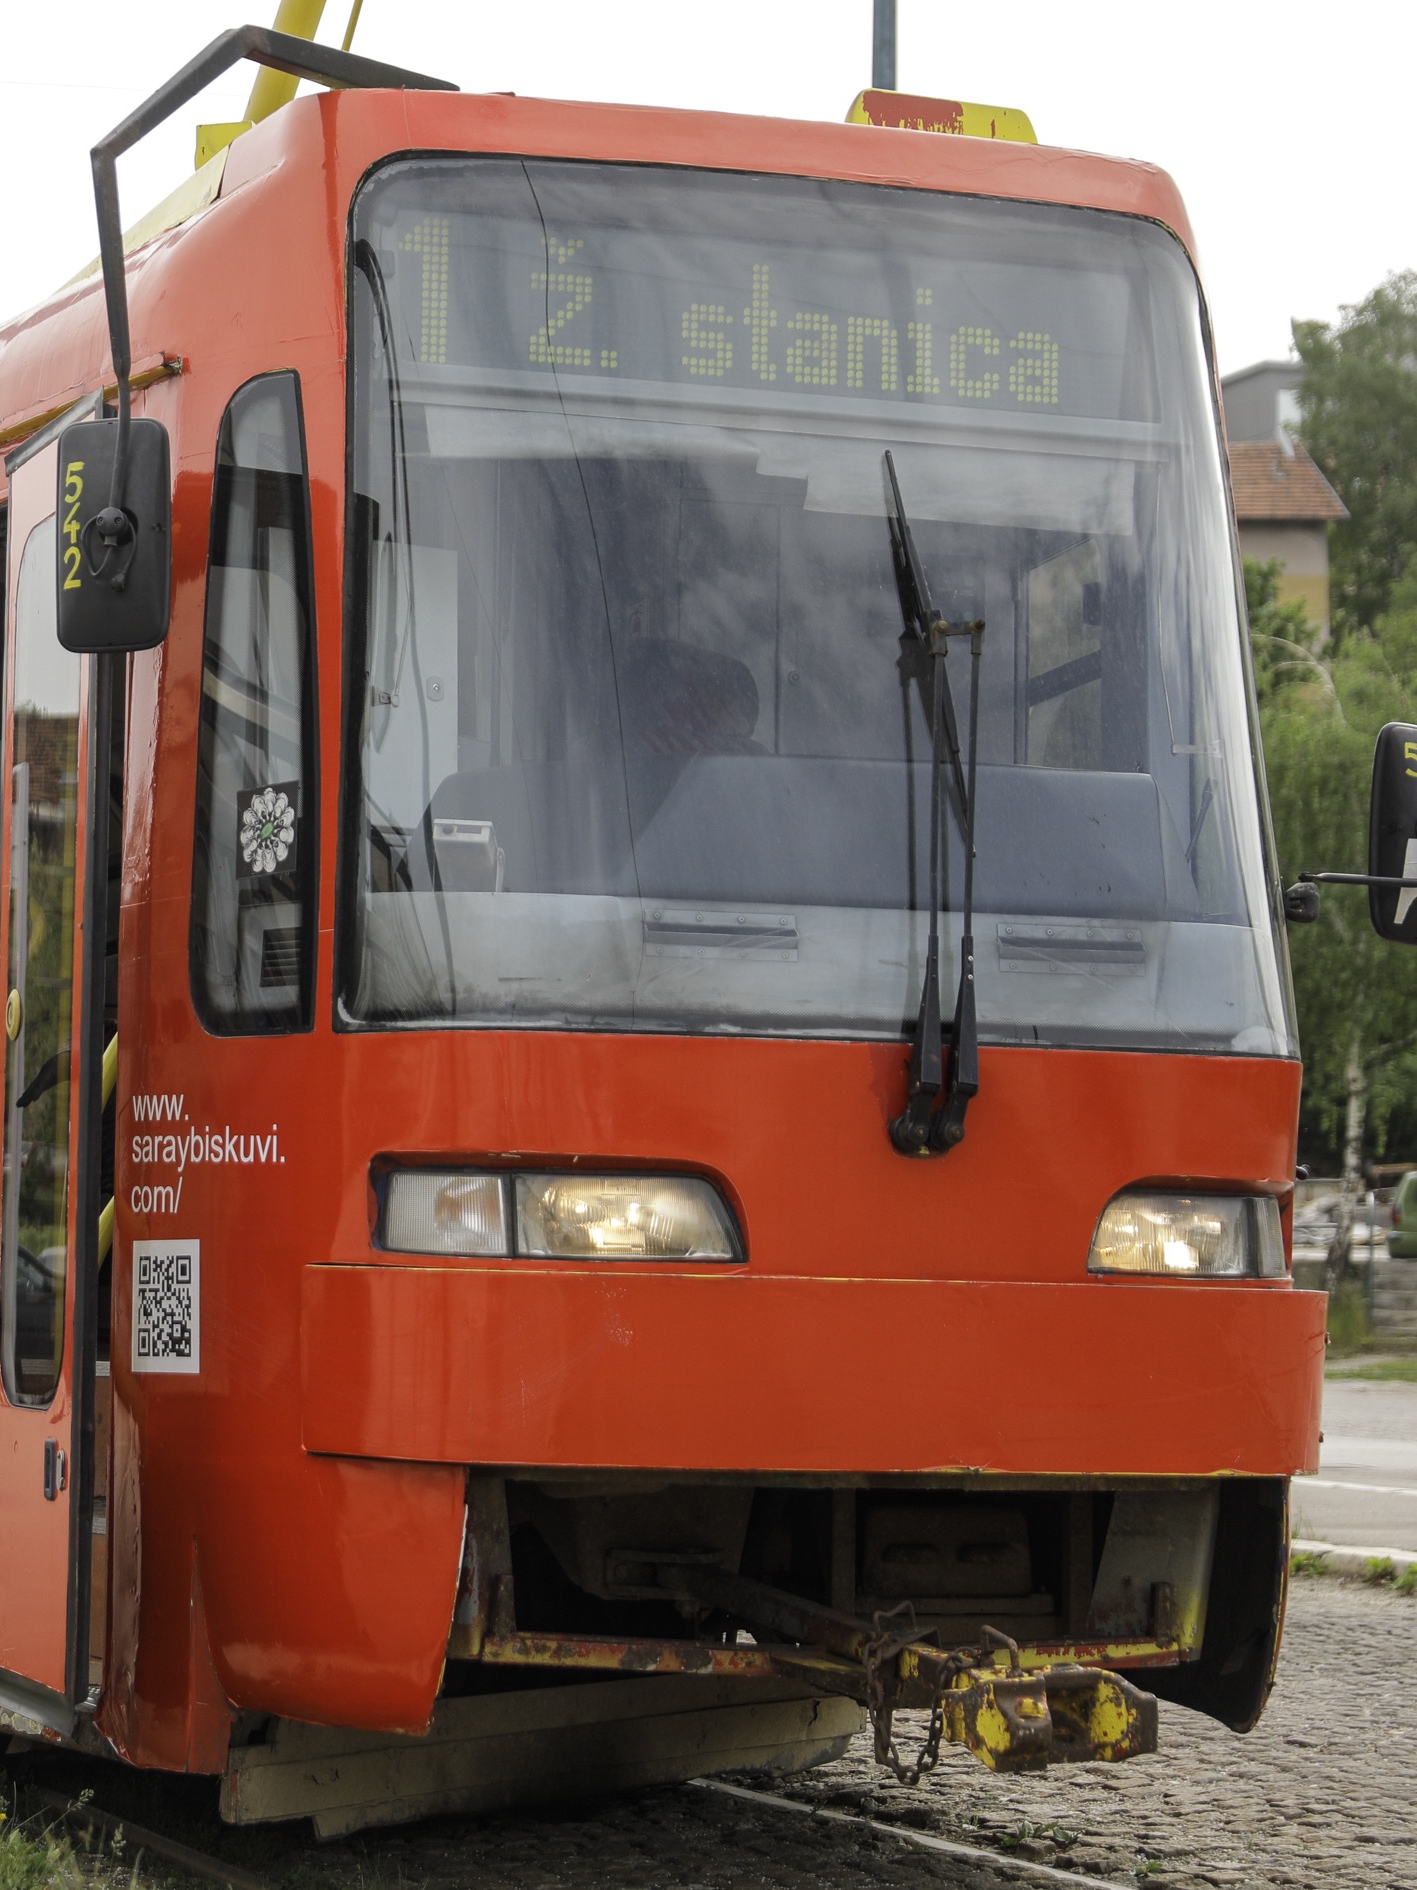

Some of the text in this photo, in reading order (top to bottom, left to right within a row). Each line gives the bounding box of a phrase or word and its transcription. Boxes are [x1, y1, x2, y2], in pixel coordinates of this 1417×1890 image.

[398, 216, 451, 366] 1
[680, 263, 1061, 405] stanica
[62, 461, 86, 590] 542
[132, 1093, 190, 1122] www.
[131, 1123, 287, 1173] saraybiskuvi.
[130, 1175, 184, 1214] com/
